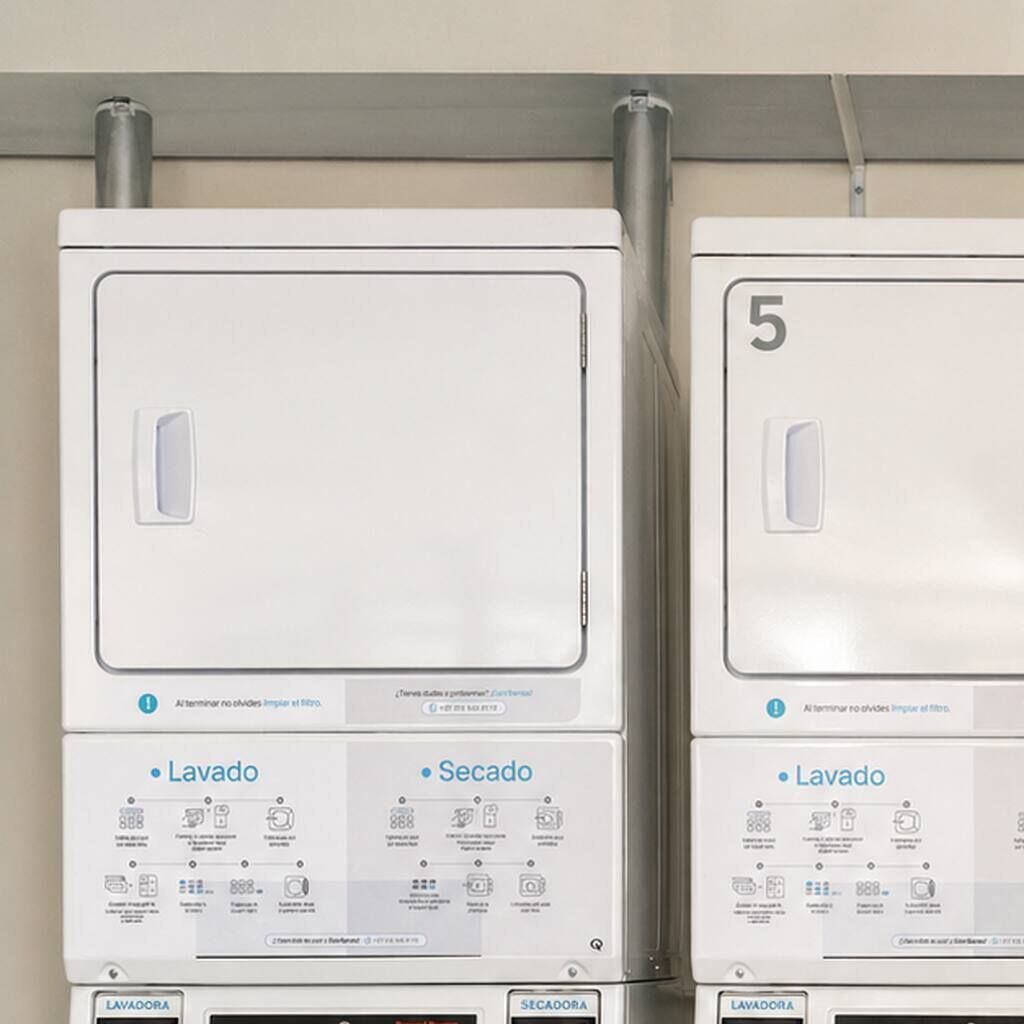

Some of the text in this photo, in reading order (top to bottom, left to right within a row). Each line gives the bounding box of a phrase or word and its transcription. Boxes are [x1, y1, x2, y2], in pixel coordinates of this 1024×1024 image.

[750, 295, 787, 351] 5
[175, 699, 184, 708] Al
[185, 699, 220, 708] terminar
[221, 699, 232, 708] no
[233, 699, 262, 708] olvides
[803, 704, 812, 713] Al
[849, 704, 860, 713] no
[861, 704, 890, 713] olvides
[168, 760, 259, 782] Lavado
[439, 760, 533, 782] Secado
[796, 765, 885, 786] Lavado
[105, 1000, 170, 1010] LAVADORA
[520, 999, 588, 1010] SECADORA
[731, 1000, 794, 1010] LAVADORA
